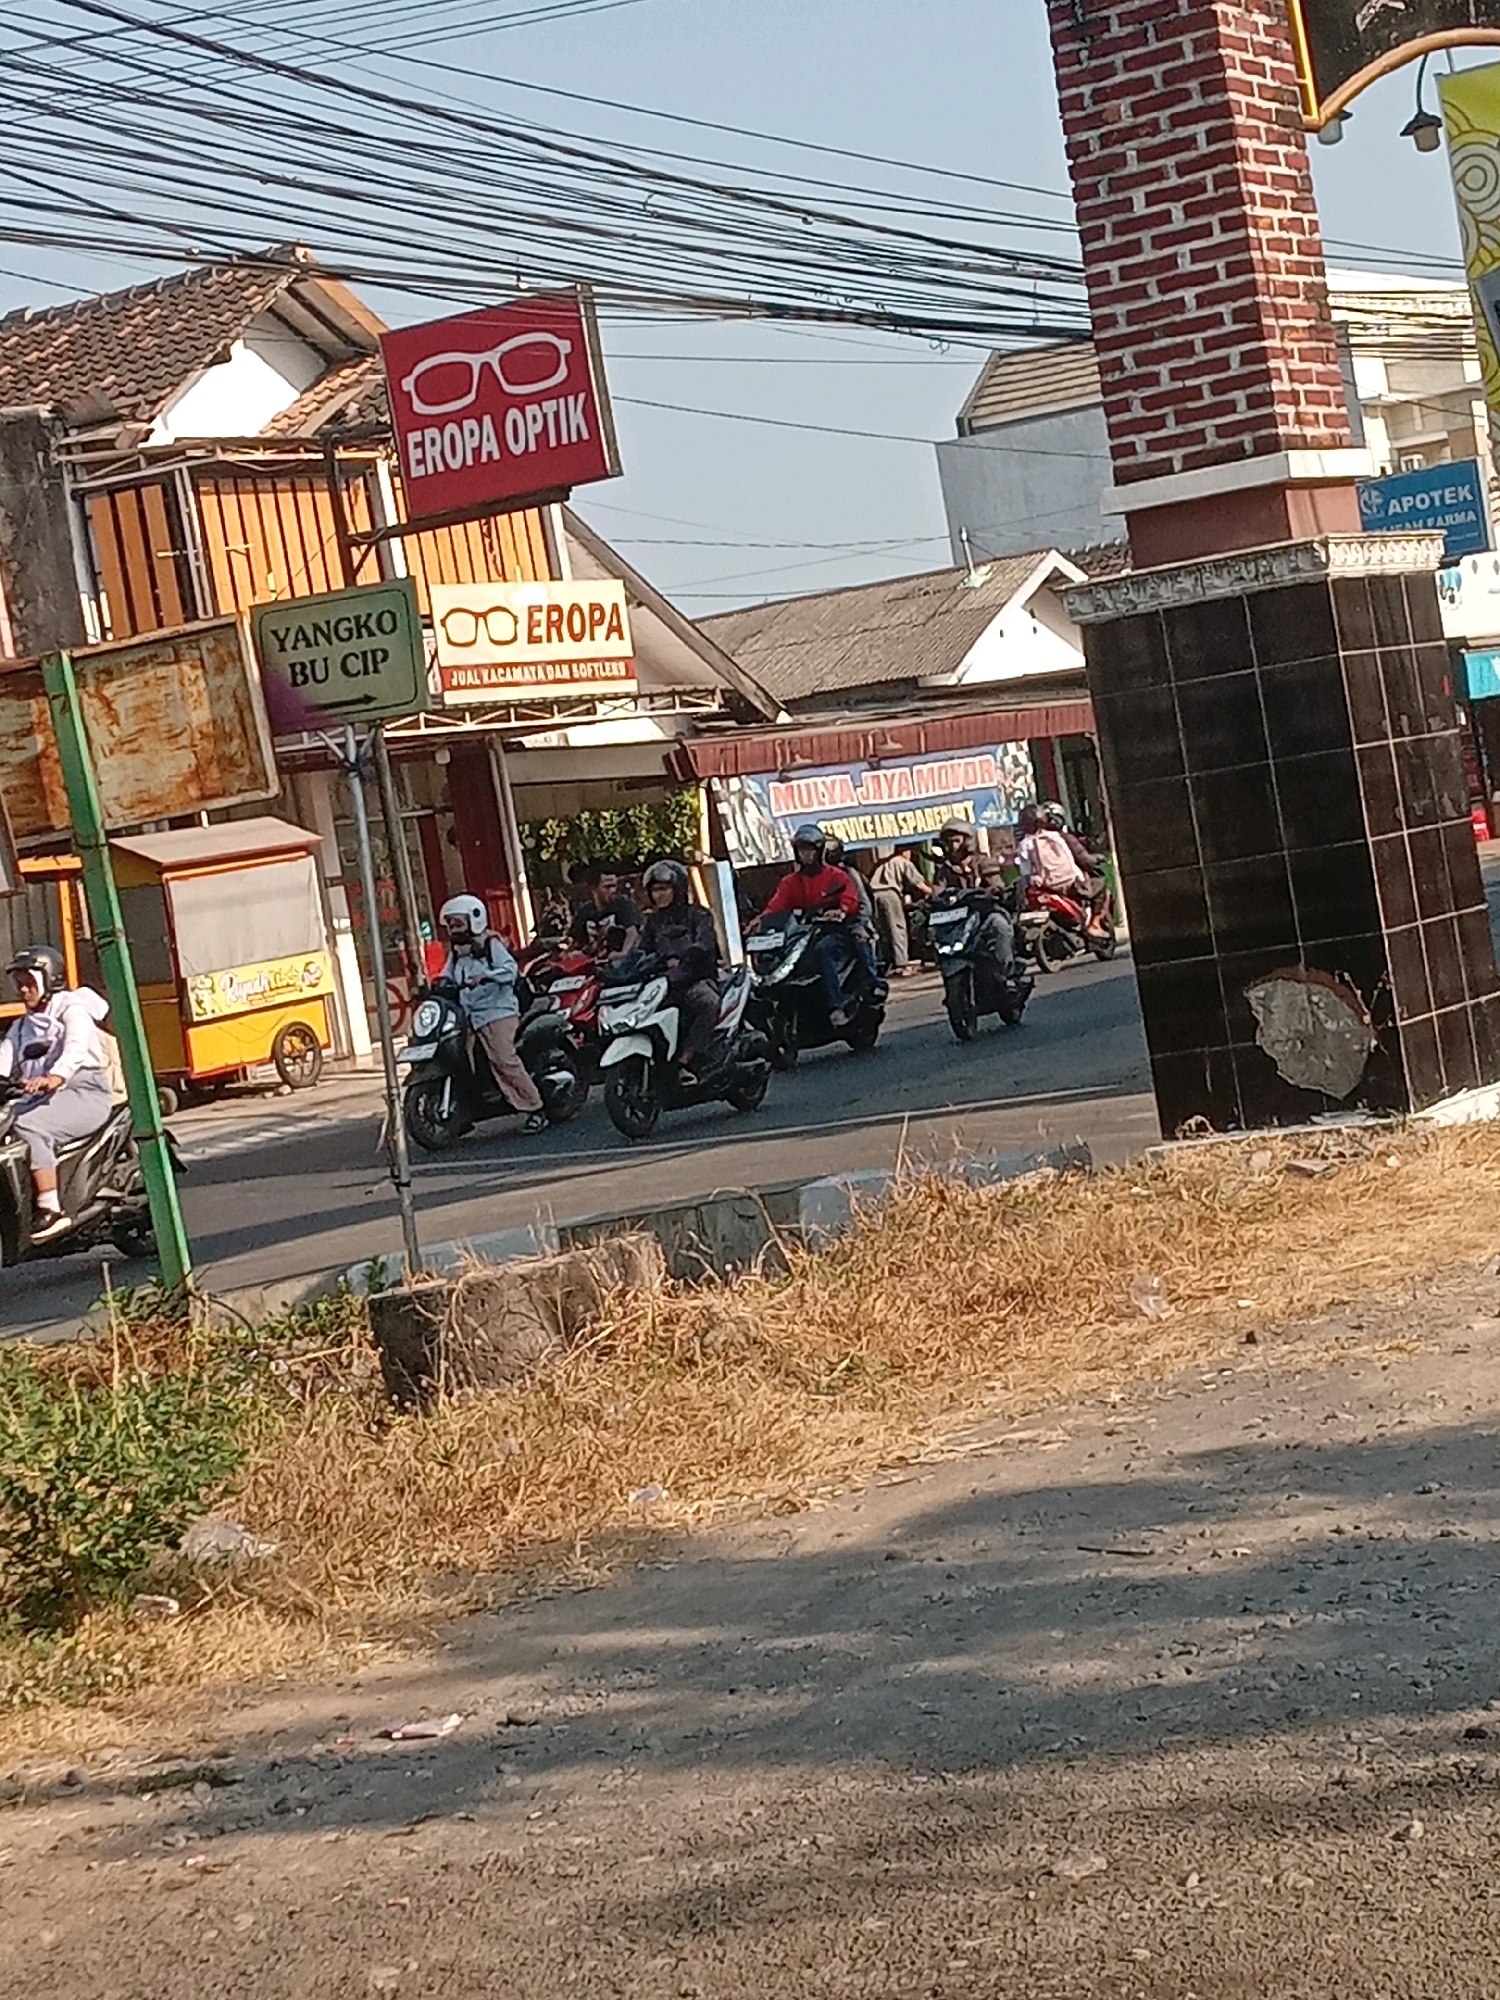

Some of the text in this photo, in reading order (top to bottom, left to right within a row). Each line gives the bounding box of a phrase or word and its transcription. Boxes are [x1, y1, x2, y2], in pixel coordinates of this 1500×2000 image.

[406, 392, 590, 479] EROPA OPTIK
[1388, 484, 1474, 516] APOTEK
[1426, 510, 1477, 527] FARMA
[270, 609, 398, 652] YANGKO
[527, 602, 625, 645] EROPA
[288, 647, 389, 688] BU CIP
[451, 669, 482, 687] JUAL
[482, 666, 546, 685] KACAMATA
[548, 664, 570, 681] DAN
[770, 757, 996, 814] MULYA JAYA MOTOR
